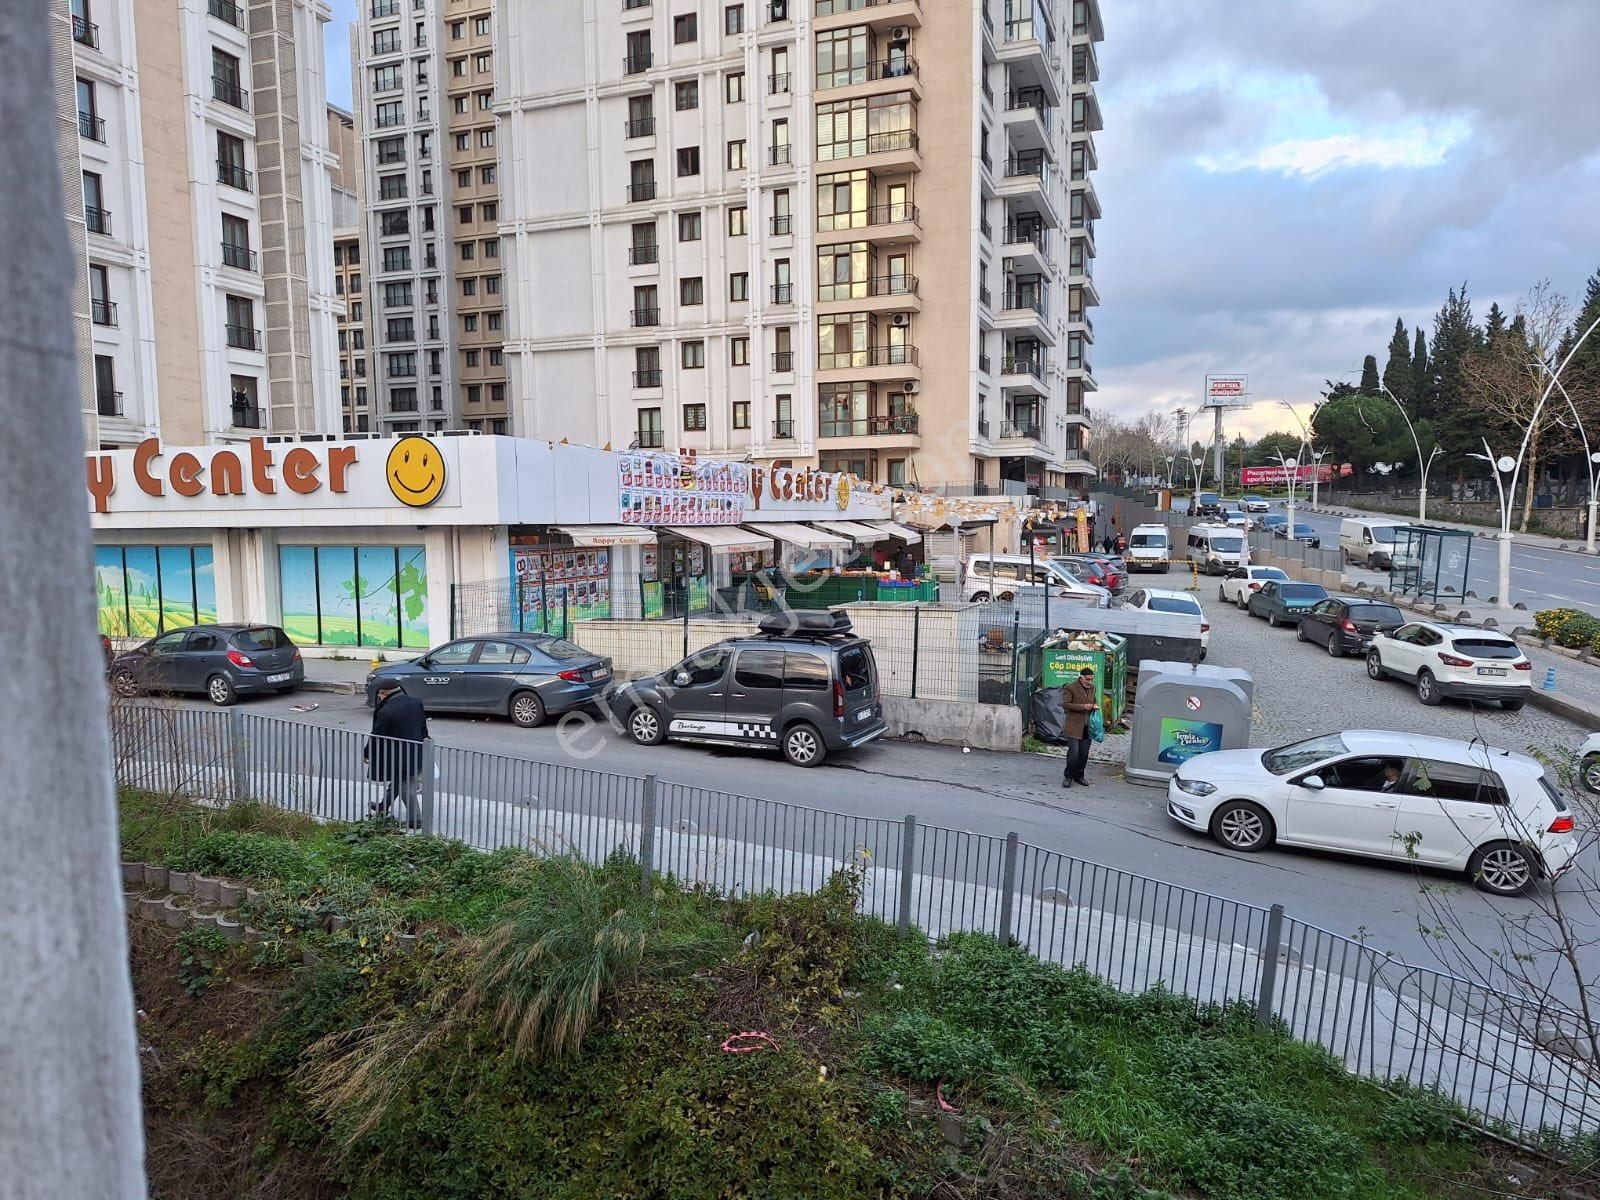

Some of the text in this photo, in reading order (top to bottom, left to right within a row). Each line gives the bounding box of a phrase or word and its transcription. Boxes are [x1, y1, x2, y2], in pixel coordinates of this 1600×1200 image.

[133, 438, 358, 496] Center
[770, 460, 832, 502] Center
[1049, 662, 1065, 671] Çöp
